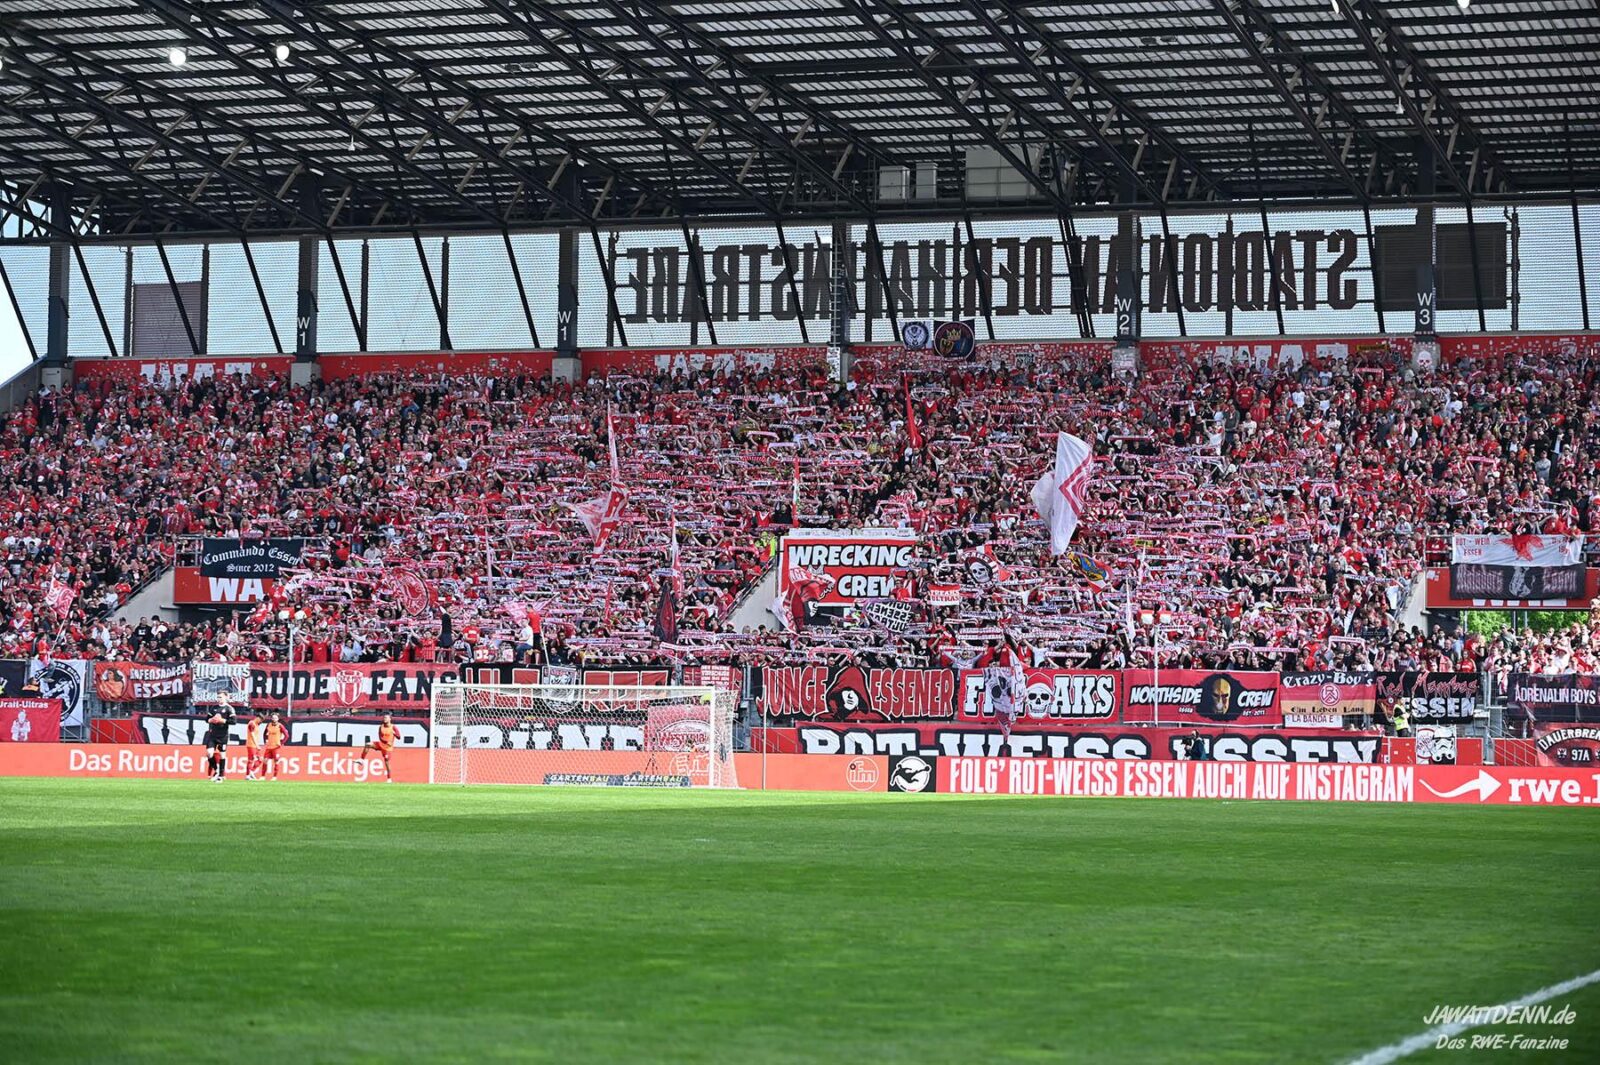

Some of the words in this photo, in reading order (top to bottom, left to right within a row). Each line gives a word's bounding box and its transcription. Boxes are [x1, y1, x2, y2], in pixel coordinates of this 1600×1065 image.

[1118, 298, 1132, 311] W
[1417, 292, 1433, 306] W
[298, 316, 311, 329] W
[558, 311, 572, 324] W
[1119, 314, 1131, 330] 2
[1419, 309, 1431, 325] 3
[299, 333, 307, 346] 1
[560, 327, 568, 341] 1
[203, 545, 265, 565] Commando
[268, 547, 300, 565] Essen
[788, 544, 913, 567] WRECKING
[226, 563, 251, 573] Since
[253, 563, 275, 573] 2012
[838, 575, 902, 598] CREW
[134, 677, 184, 698] ESSEN
[250, 668, 331, 701] RUDE
[370, 669, 458, 701] FANS
[755, 665, 829, 717] JUNGE
[870, 667, 955, 718] ESSENER
[1376, 671, 1406, 698] Red
[1411, 669, 1478, 699] Mambas
[1129, 685, 1203, 704] NORTHSIDE
[1237, 688, 1276, 708] CREW
[1515, 684, 1569, 704] ADRENALIN
[1571, 687, 1597, 705] BOYS
[1571, 748, 1591, 761] 97A
[69, 749, 112, 772] Das
[118, 749, 193, 772] Runde
[308, 751, 389, 782] Eckige.
[849, 760, 876, 783] ifm
[550, 774, 609, 782] GARTENBAU
[622, 774, 683, 783] GARTENBAU
[1010, 759, 1118, 796] ROT-WEISS
[1123, 760, 1187, 797] ESSEN
[1193, 763, 1247, 799] AUCH
[1252, 764, 1290, 800] AUF
[1296, 765, 1414, 802] INSTAGRAM
